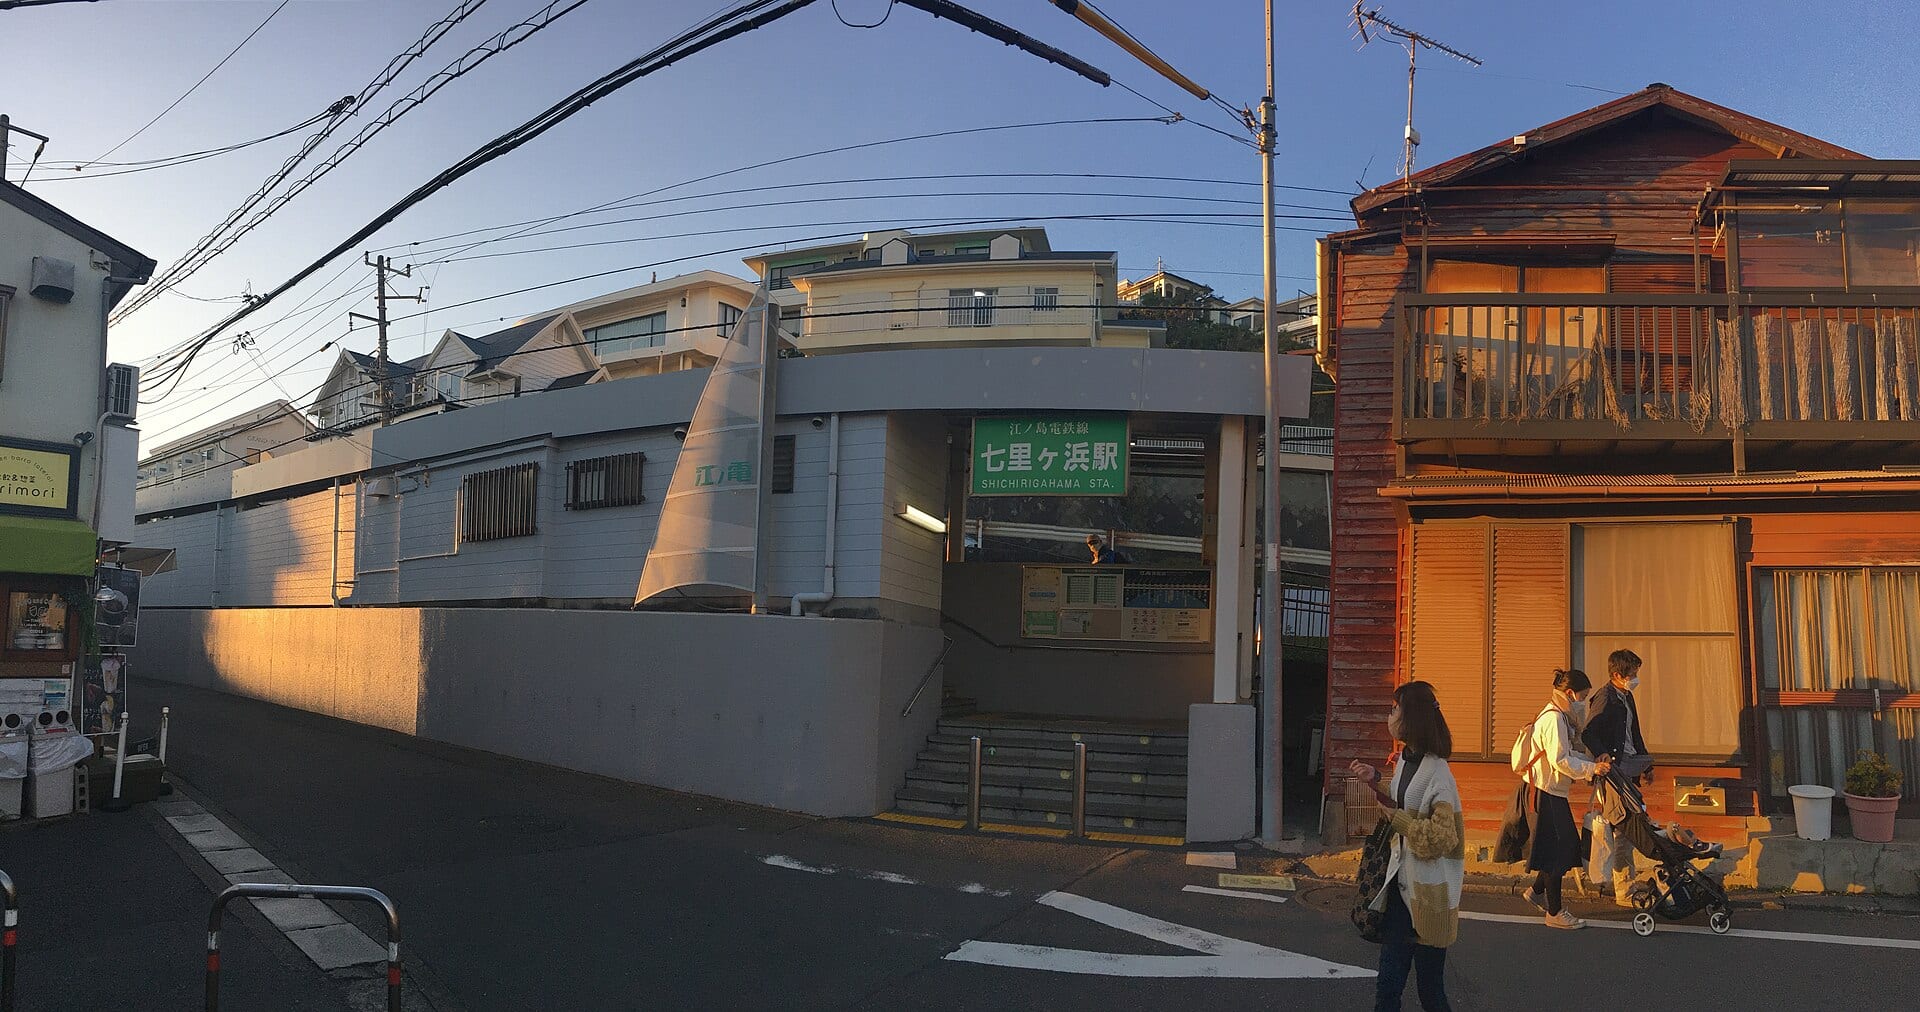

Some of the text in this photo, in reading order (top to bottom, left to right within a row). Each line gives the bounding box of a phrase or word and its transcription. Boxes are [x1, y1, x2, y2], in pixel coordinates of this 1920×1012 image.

[1009, 421, 1089, 435] 江ノ島電鉄線
[694, 460, 753, 487] 江ノ電
[981, 478, 1115, 489] SHICHIRIGAHAMA STA.
